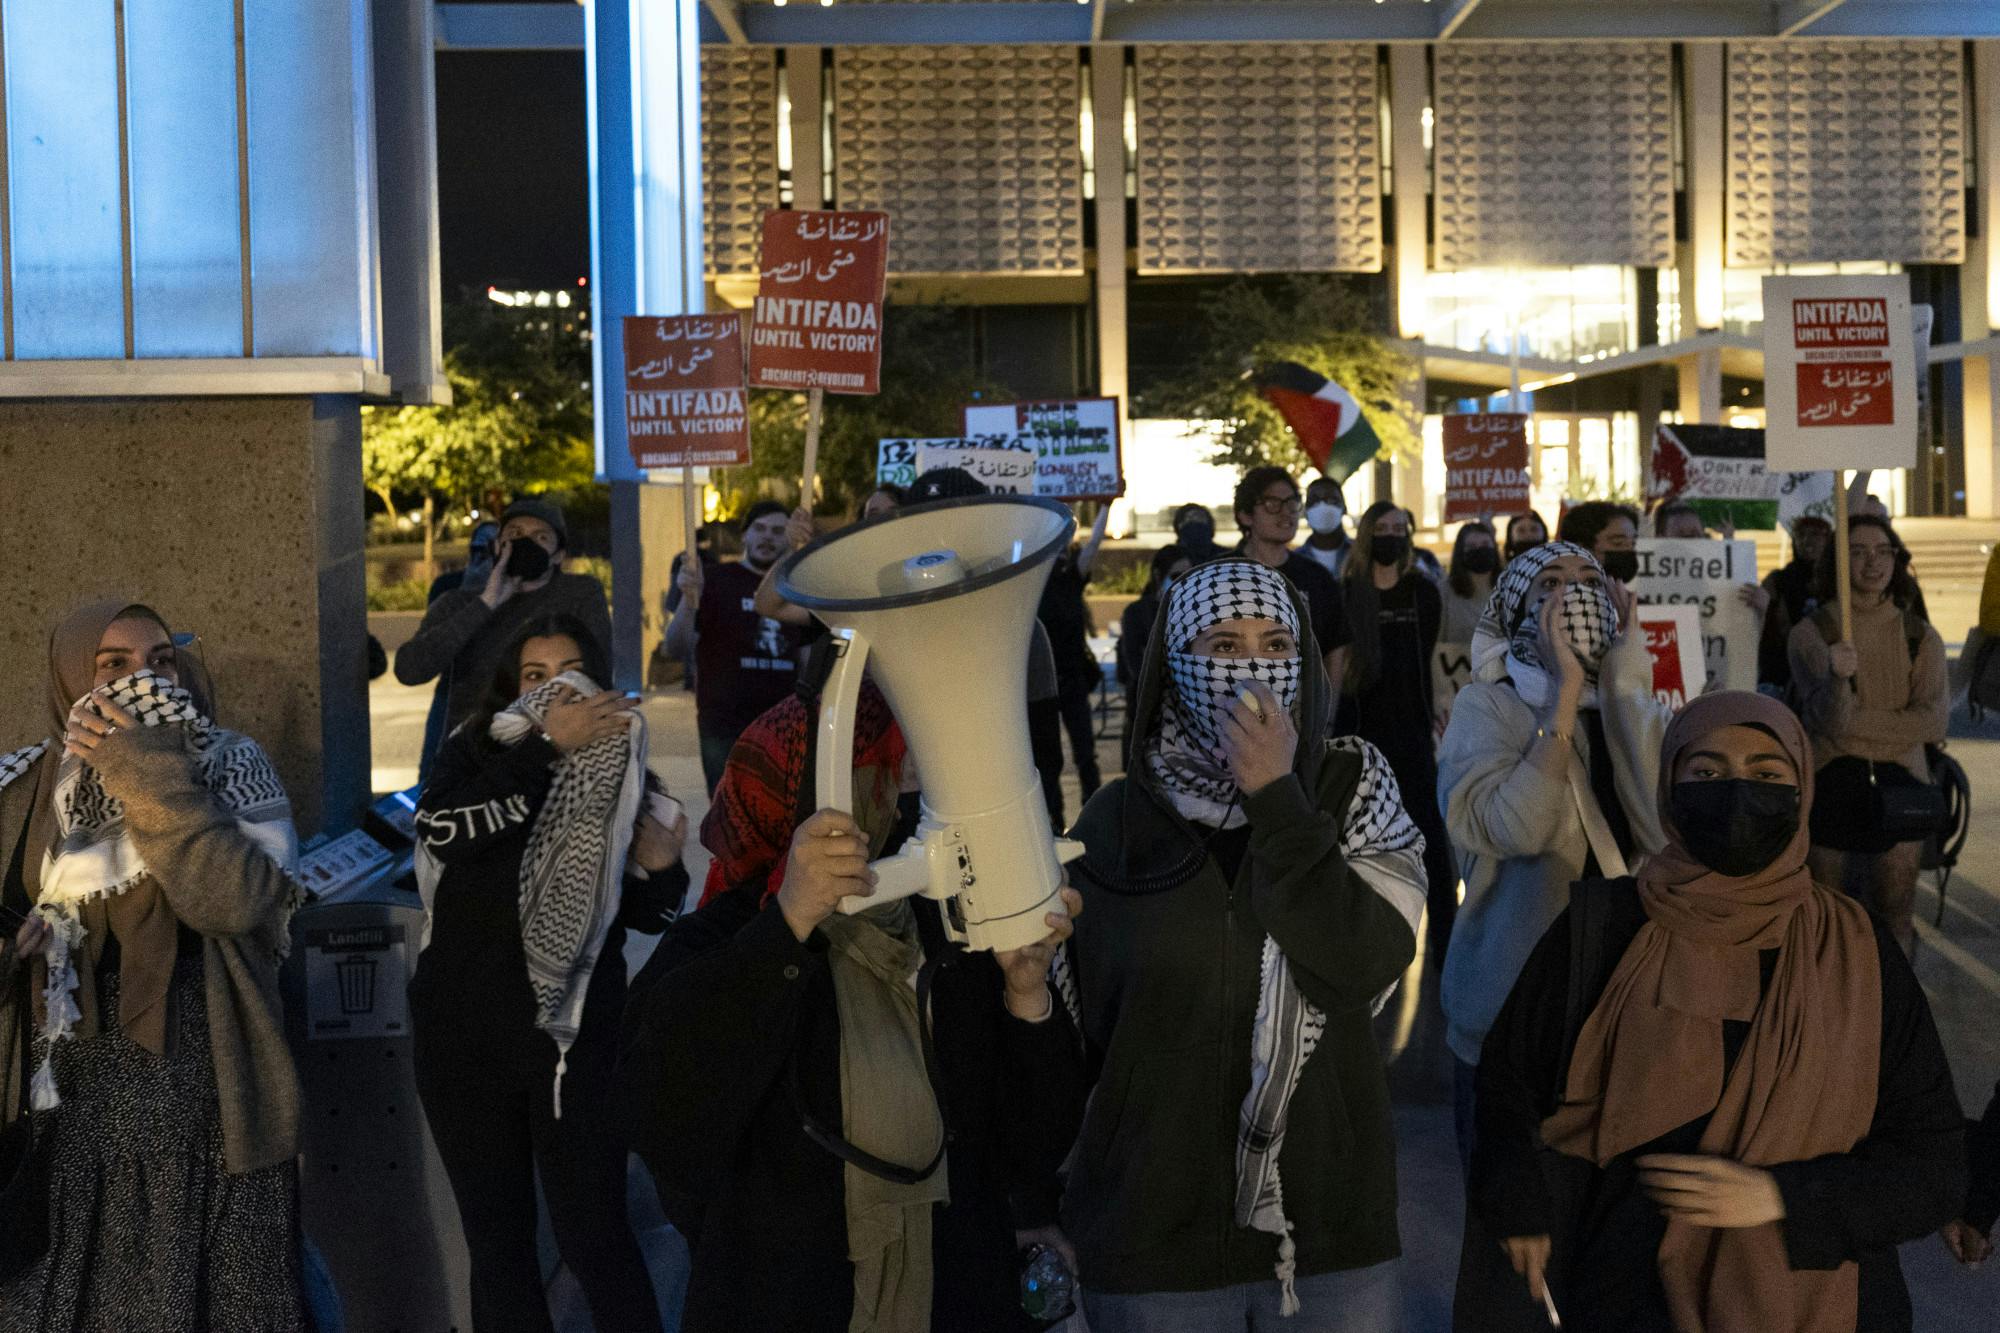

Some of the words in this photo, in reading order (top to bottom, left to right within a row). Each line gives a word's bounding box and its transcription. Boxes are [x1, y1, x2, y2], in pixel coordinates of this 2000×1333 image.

[797, 216, 885, 241] الانتفاضة
[756, 297, 877, 330] INTIFADA
[1795, 302, 1886, 324] INTIFADA
[754, 329, 803, 349] UNTIL
[811, 332, 876, 352] VICTORY
[1798, 326, 1833, 342] UNTIL
[1836, 325, 1887, 341] VICTORY
[629, 391, 744, 418] INTIFADA
[630, 419, 676, 436] UNTIL
[681, 417, 745, 433] VICTORY
[1446, 468, 1531, 487] INTIFADA
[1637, 545, 1732, 579] Israel
